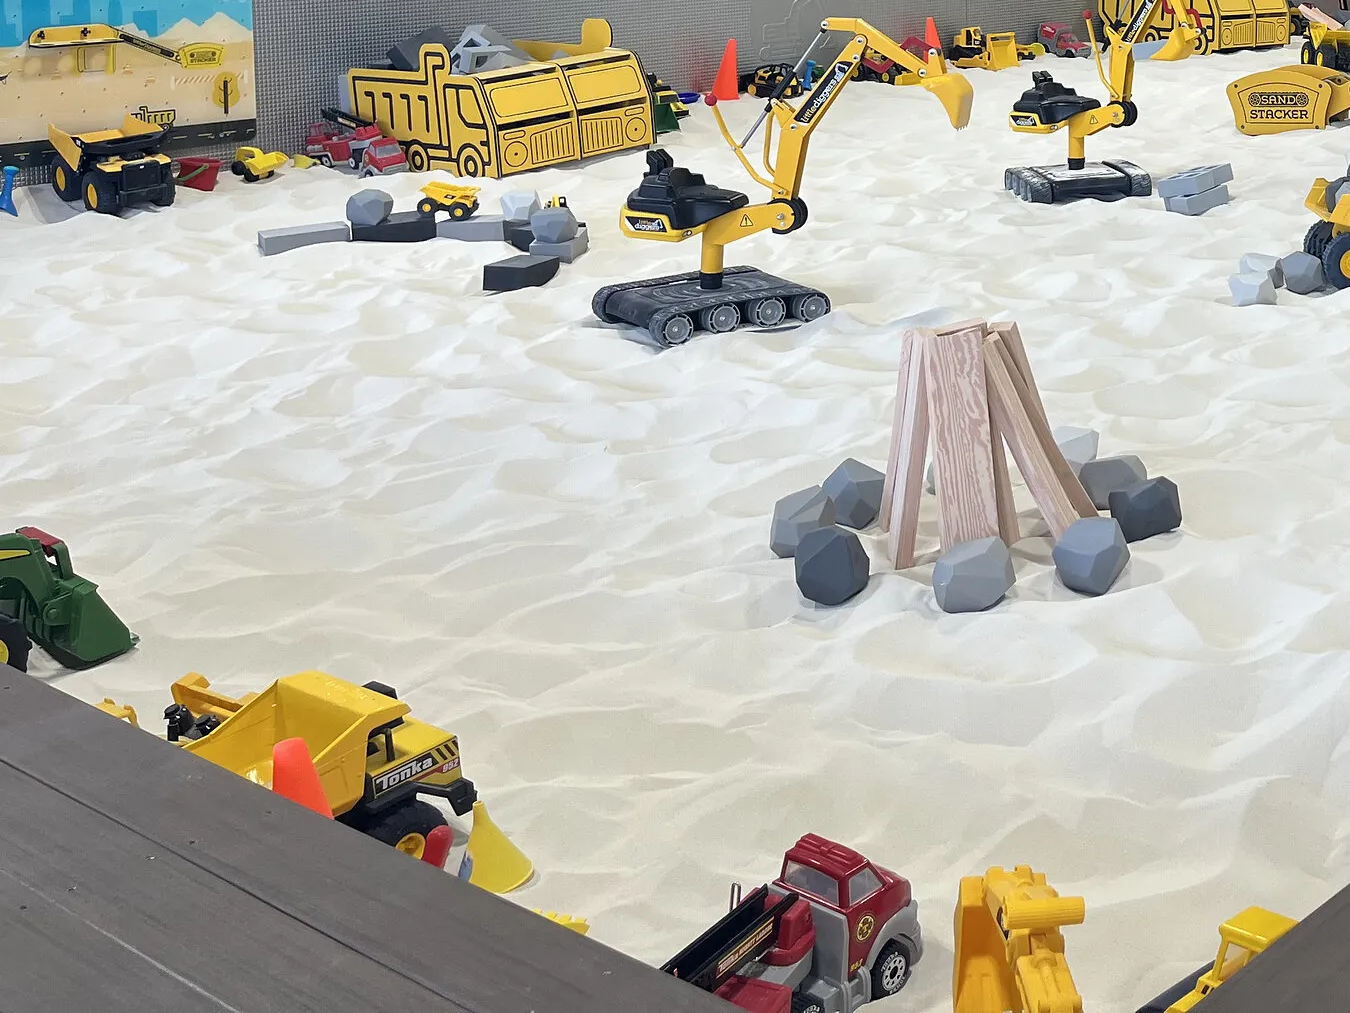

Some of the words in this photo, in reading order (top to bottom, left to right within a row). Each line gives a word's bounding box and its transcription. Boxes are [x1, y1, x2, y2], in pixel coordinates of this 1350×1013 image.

[1261, 94, 1296, 105] SAND
[1249, 109, 1309, 119] STACKER
[375, 757, 433, 790] Tonka
[442, 757, 459, 773] 952
